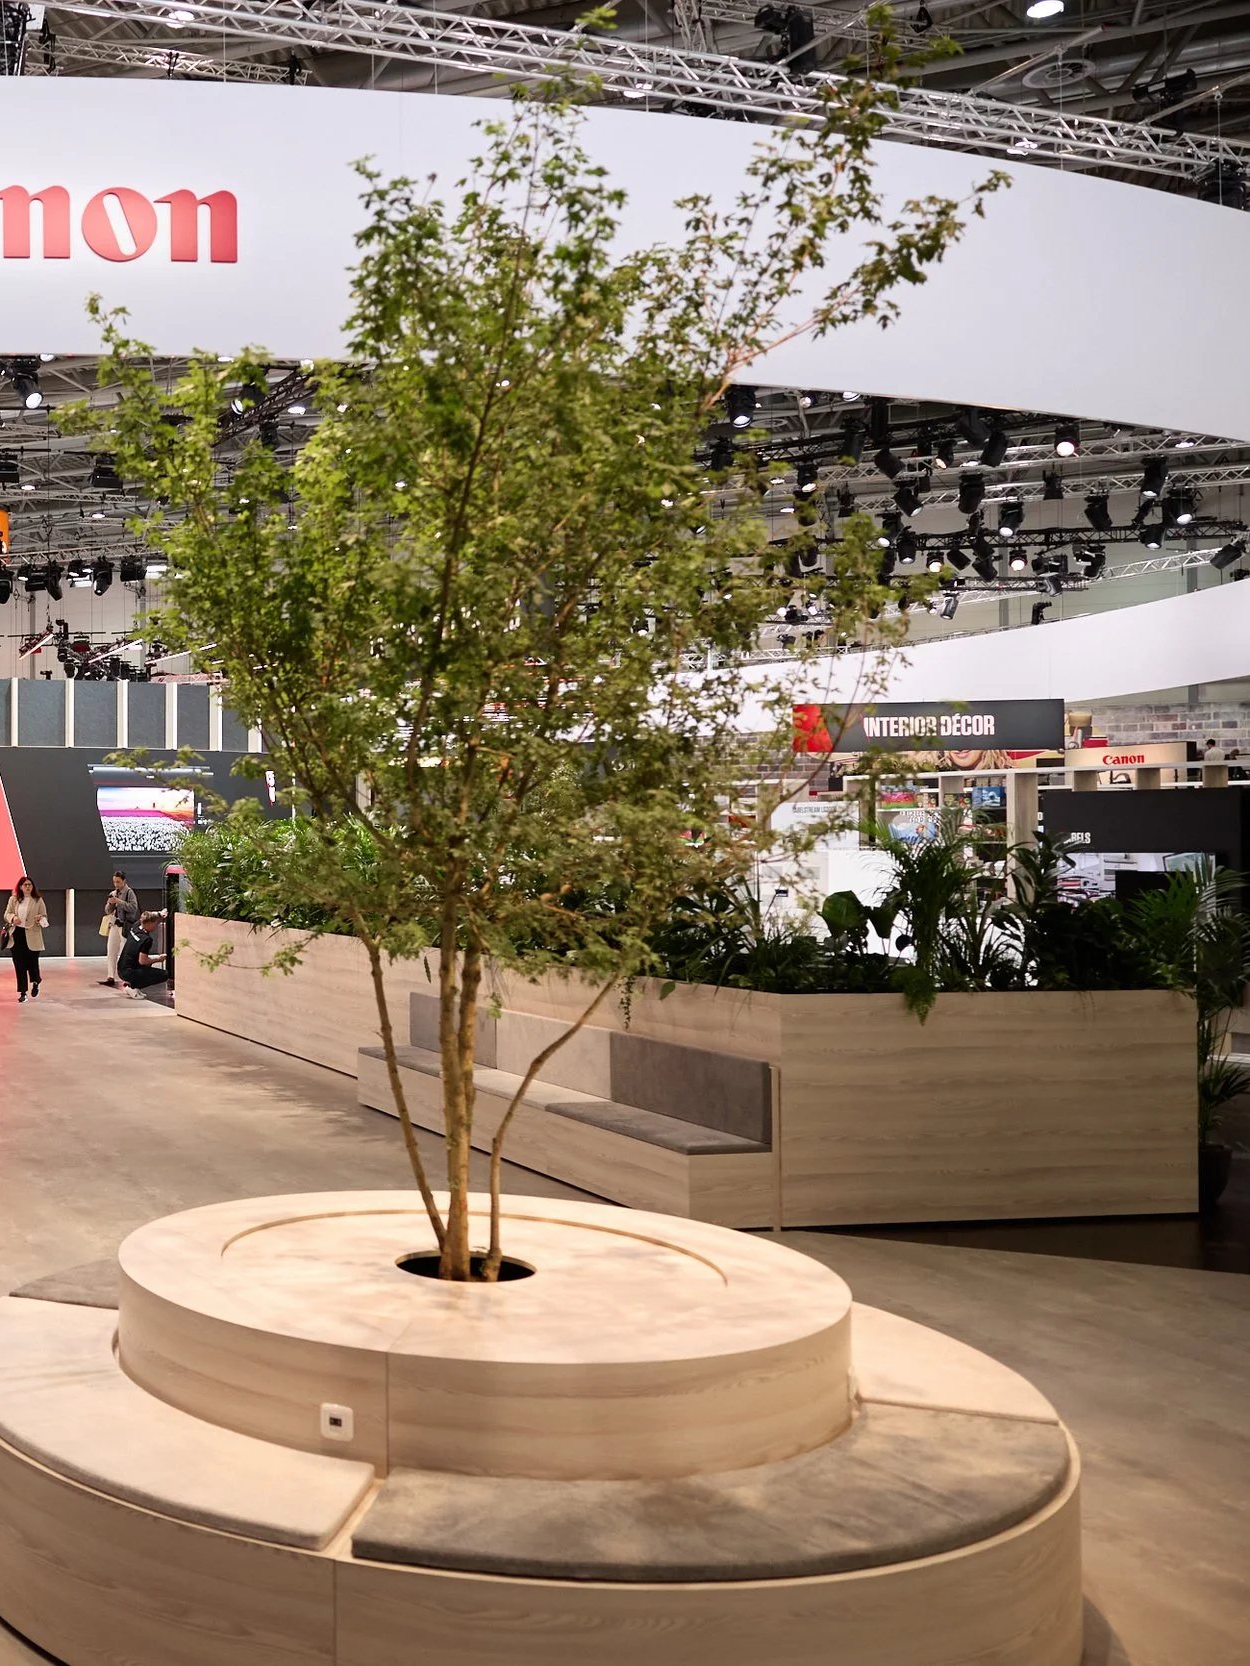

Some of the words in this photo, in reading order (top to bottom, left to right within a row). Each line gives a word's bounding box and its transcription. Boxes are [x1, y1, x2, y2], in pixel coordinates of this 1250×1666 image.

[862, 715, 937, 737] INTERIOR
[940, 713, 995, 736] DÉCOR
[1102, 754, 1145, 766] Canon
